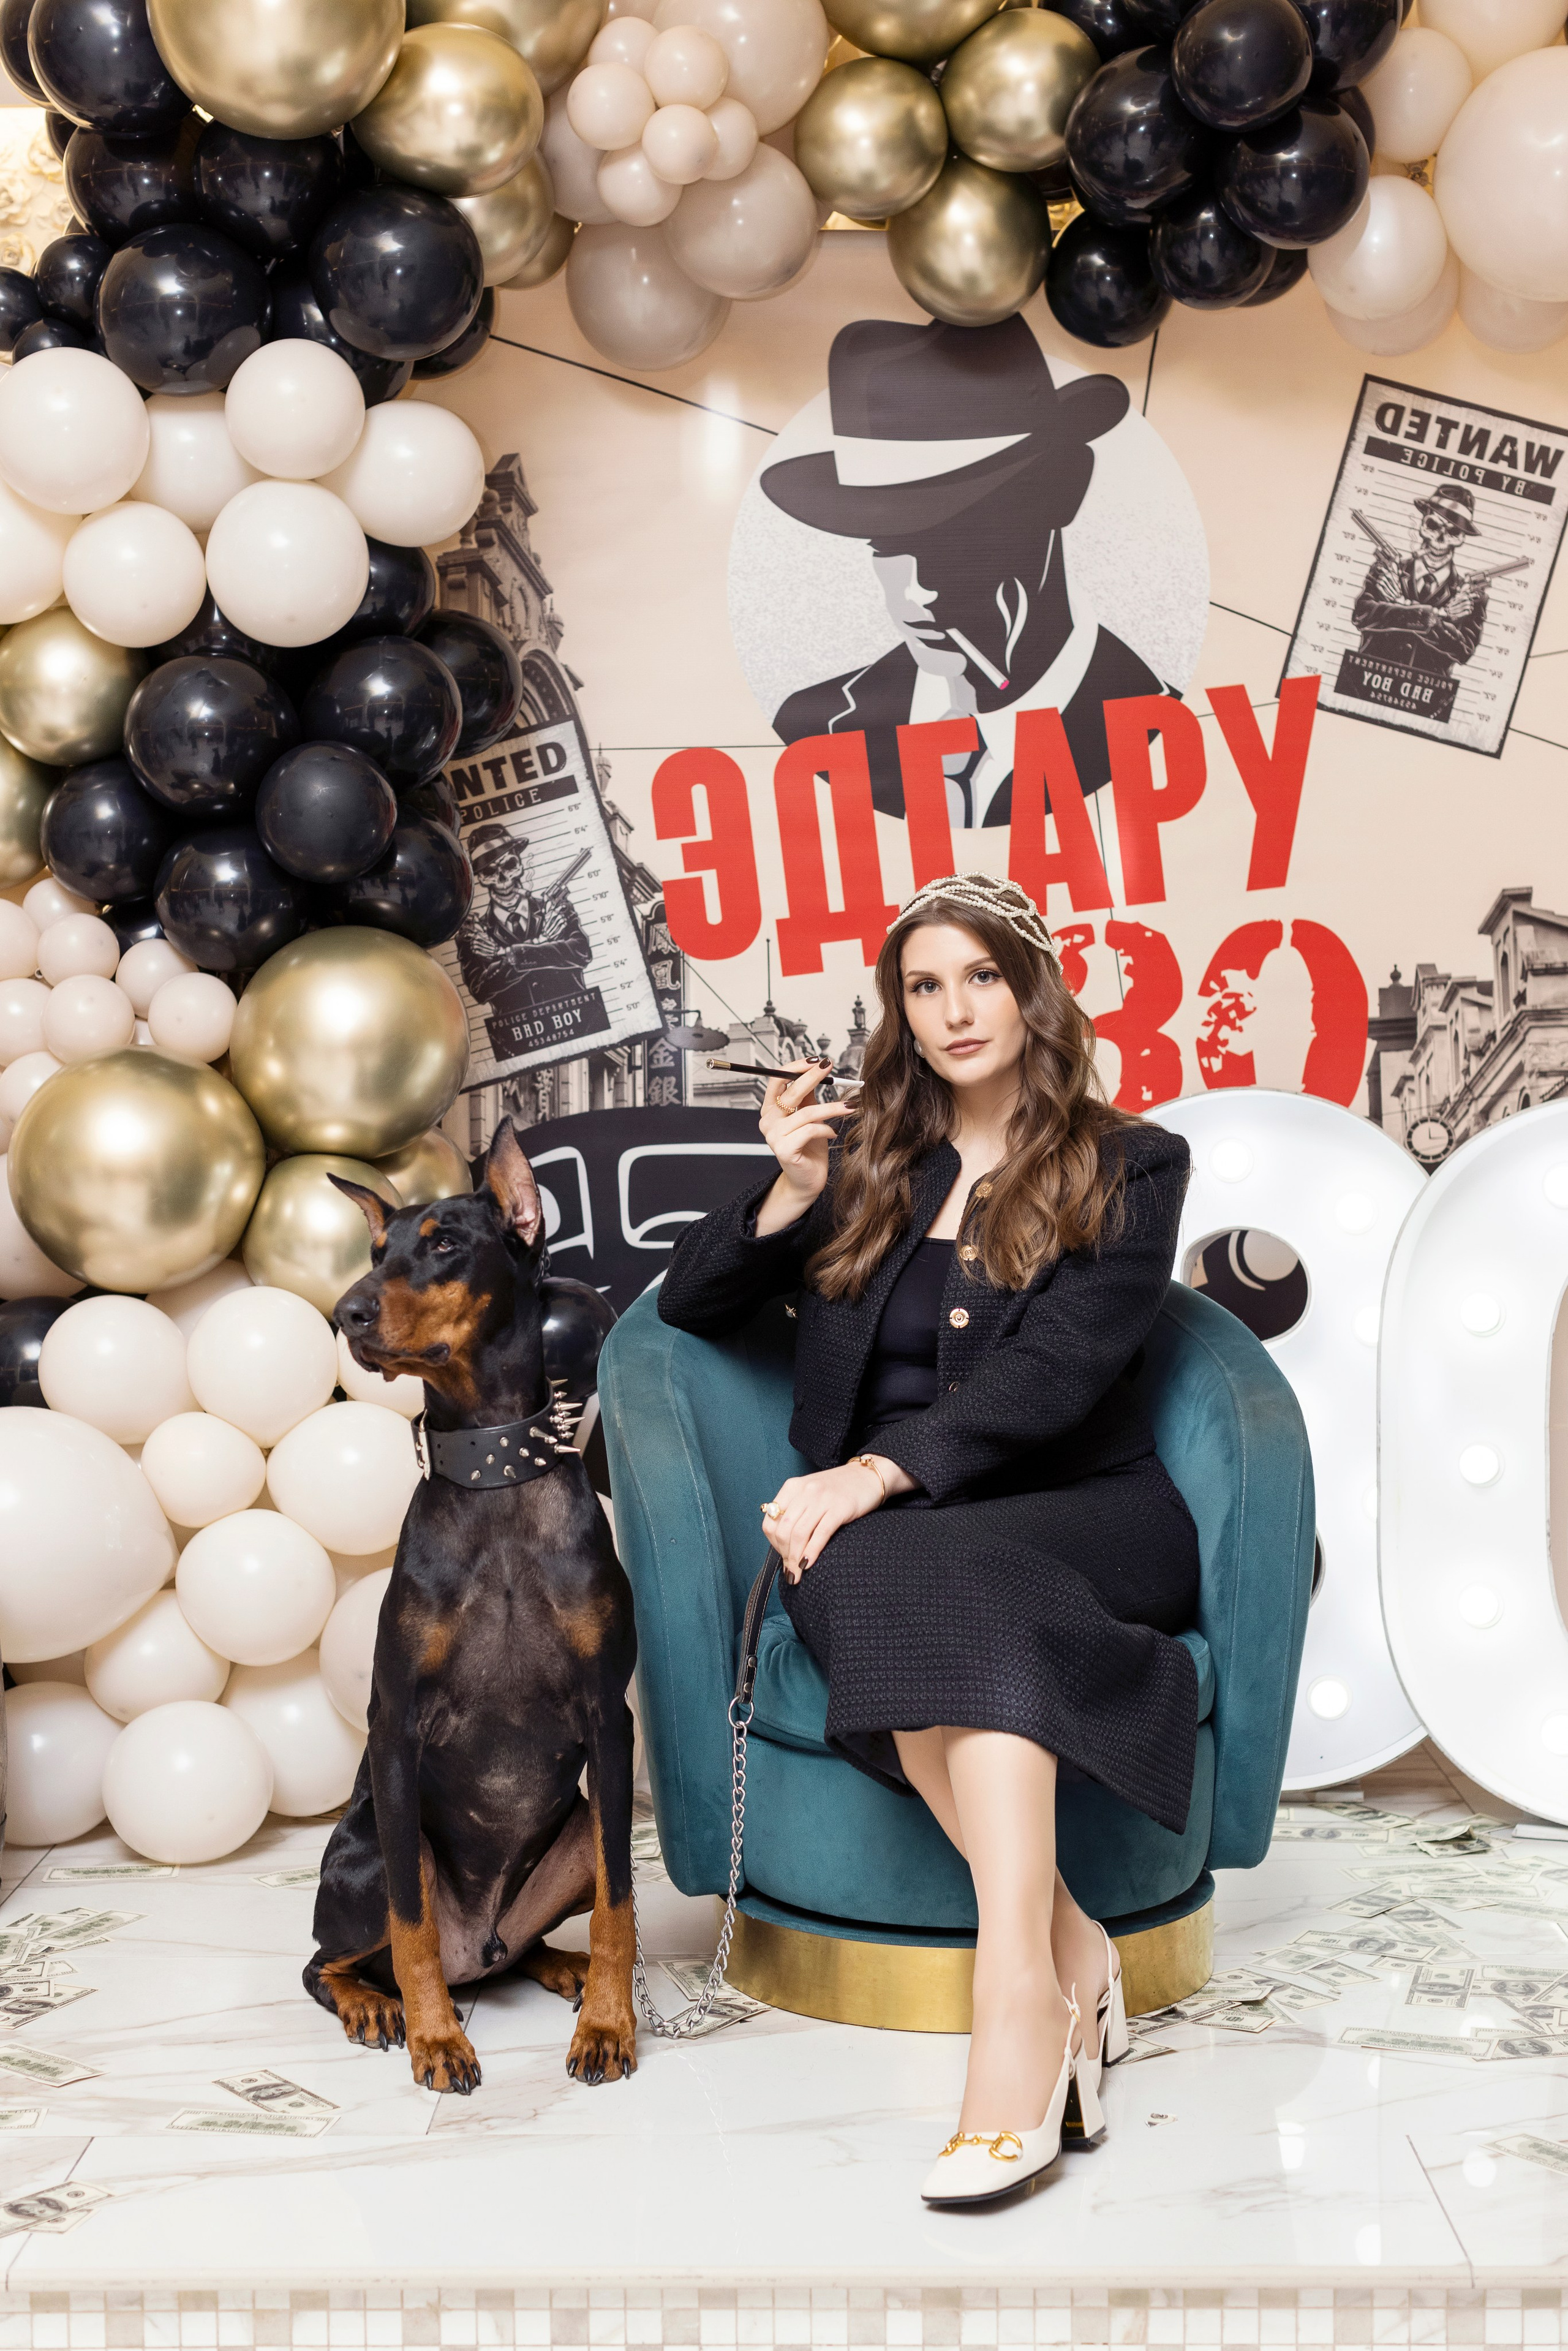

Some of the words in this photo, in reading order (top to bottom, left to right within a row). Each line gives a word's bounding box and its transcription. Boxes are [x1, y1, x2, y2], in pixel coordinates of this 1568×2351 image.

[450, 742, 567, 801] NTED
[651, 675, 1321, 976] ЭДГАРУ
[492, 1013, 527, 1030] POLICE
[511, 1021, 545, 1041] BAD
[552, 1008, 582, 1030] BOY
[1051, 918, 1368, 1115] 80
